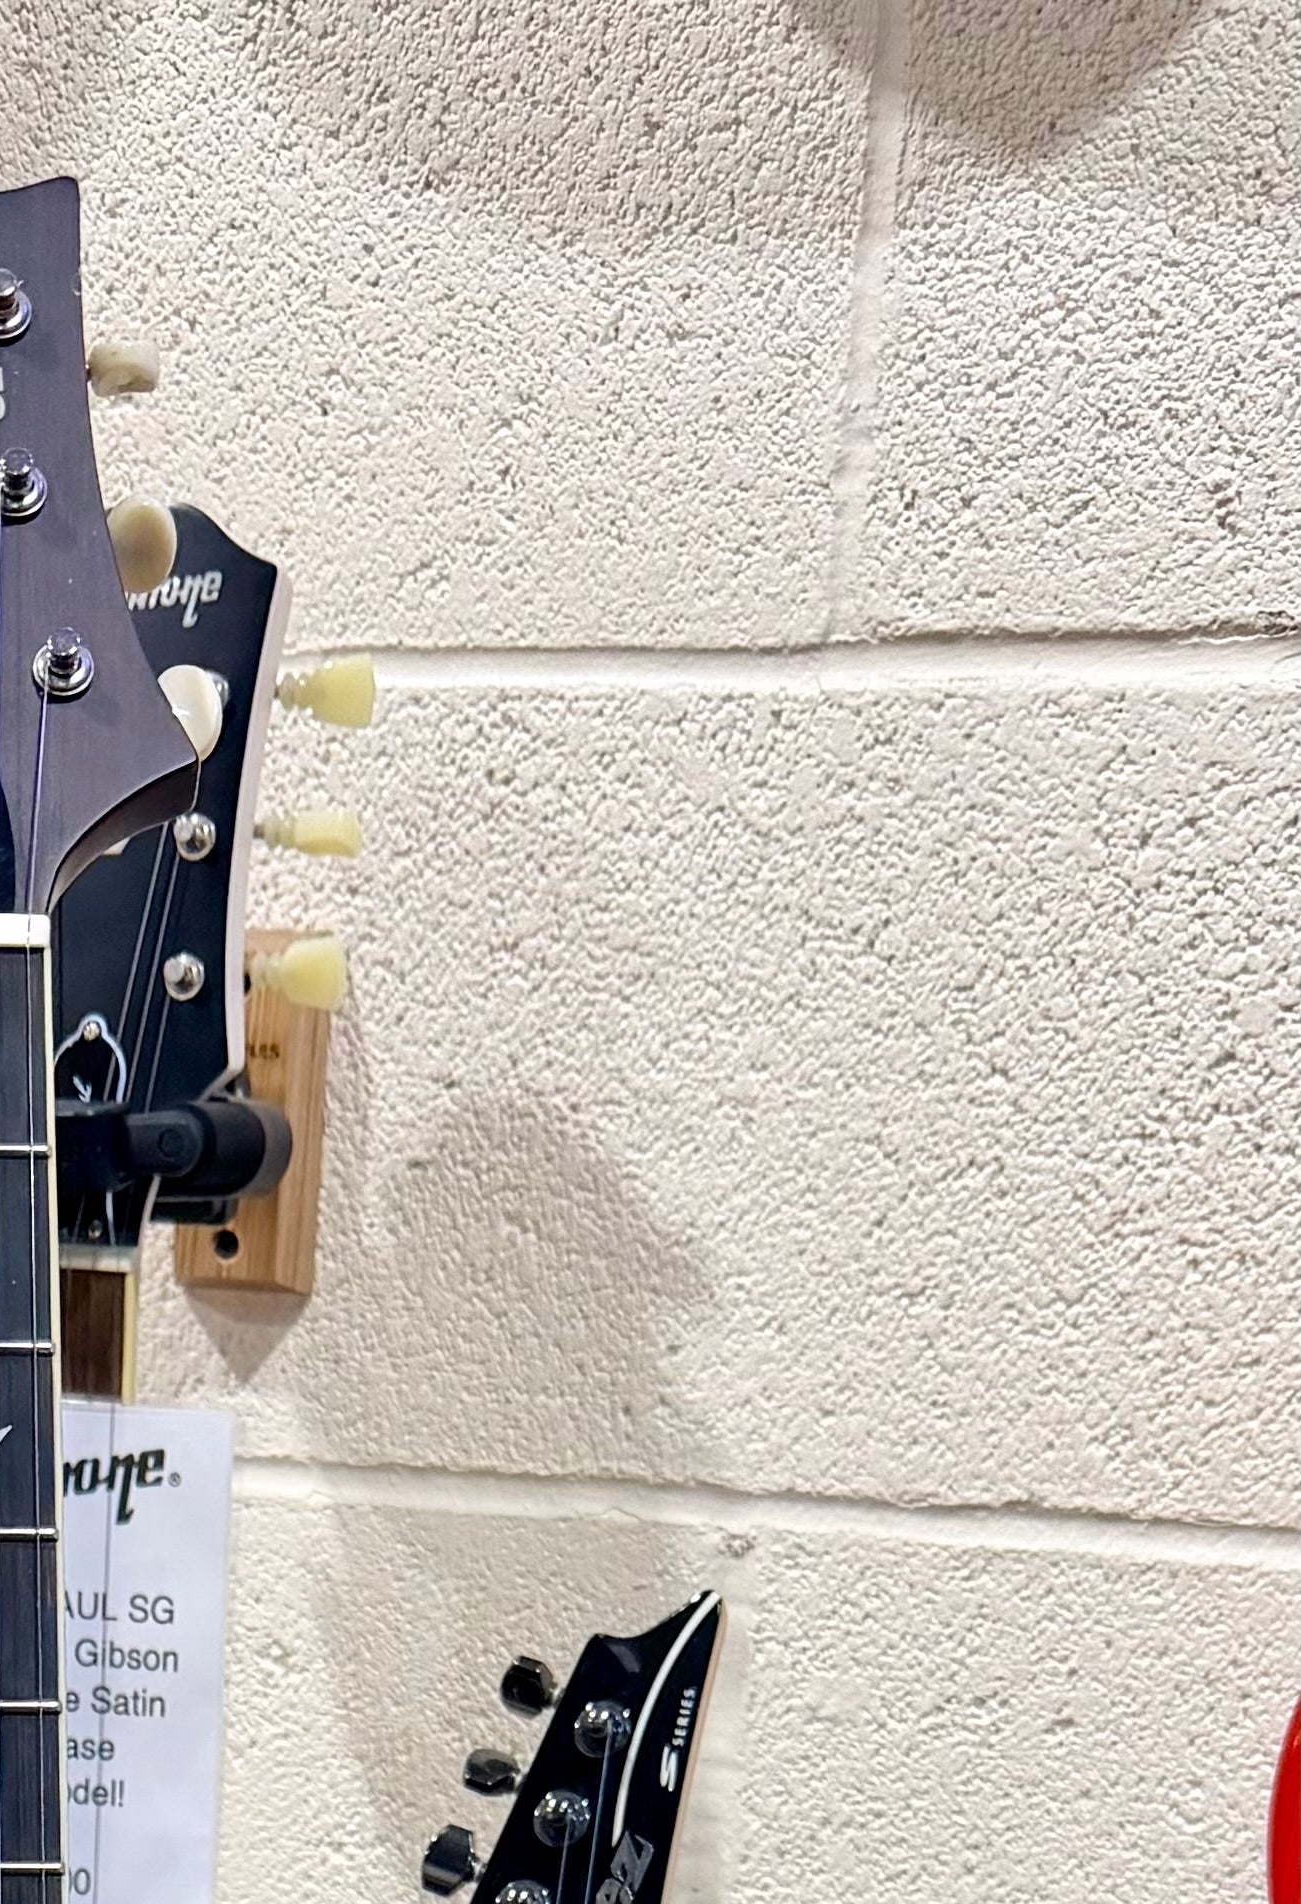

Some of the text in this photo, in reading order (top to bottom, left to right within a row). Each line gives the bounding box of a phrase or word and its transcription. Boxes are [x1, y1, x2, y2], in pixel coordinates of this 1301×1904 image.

[128, 1594, 175, 1625] SG
[74, 1638, 178, 1672] Gibson
[91, 1685, 166, 1718] Satin
[672, 1686, 697, 1747] SERIES
[66, 1738, 115, 1761] ase
